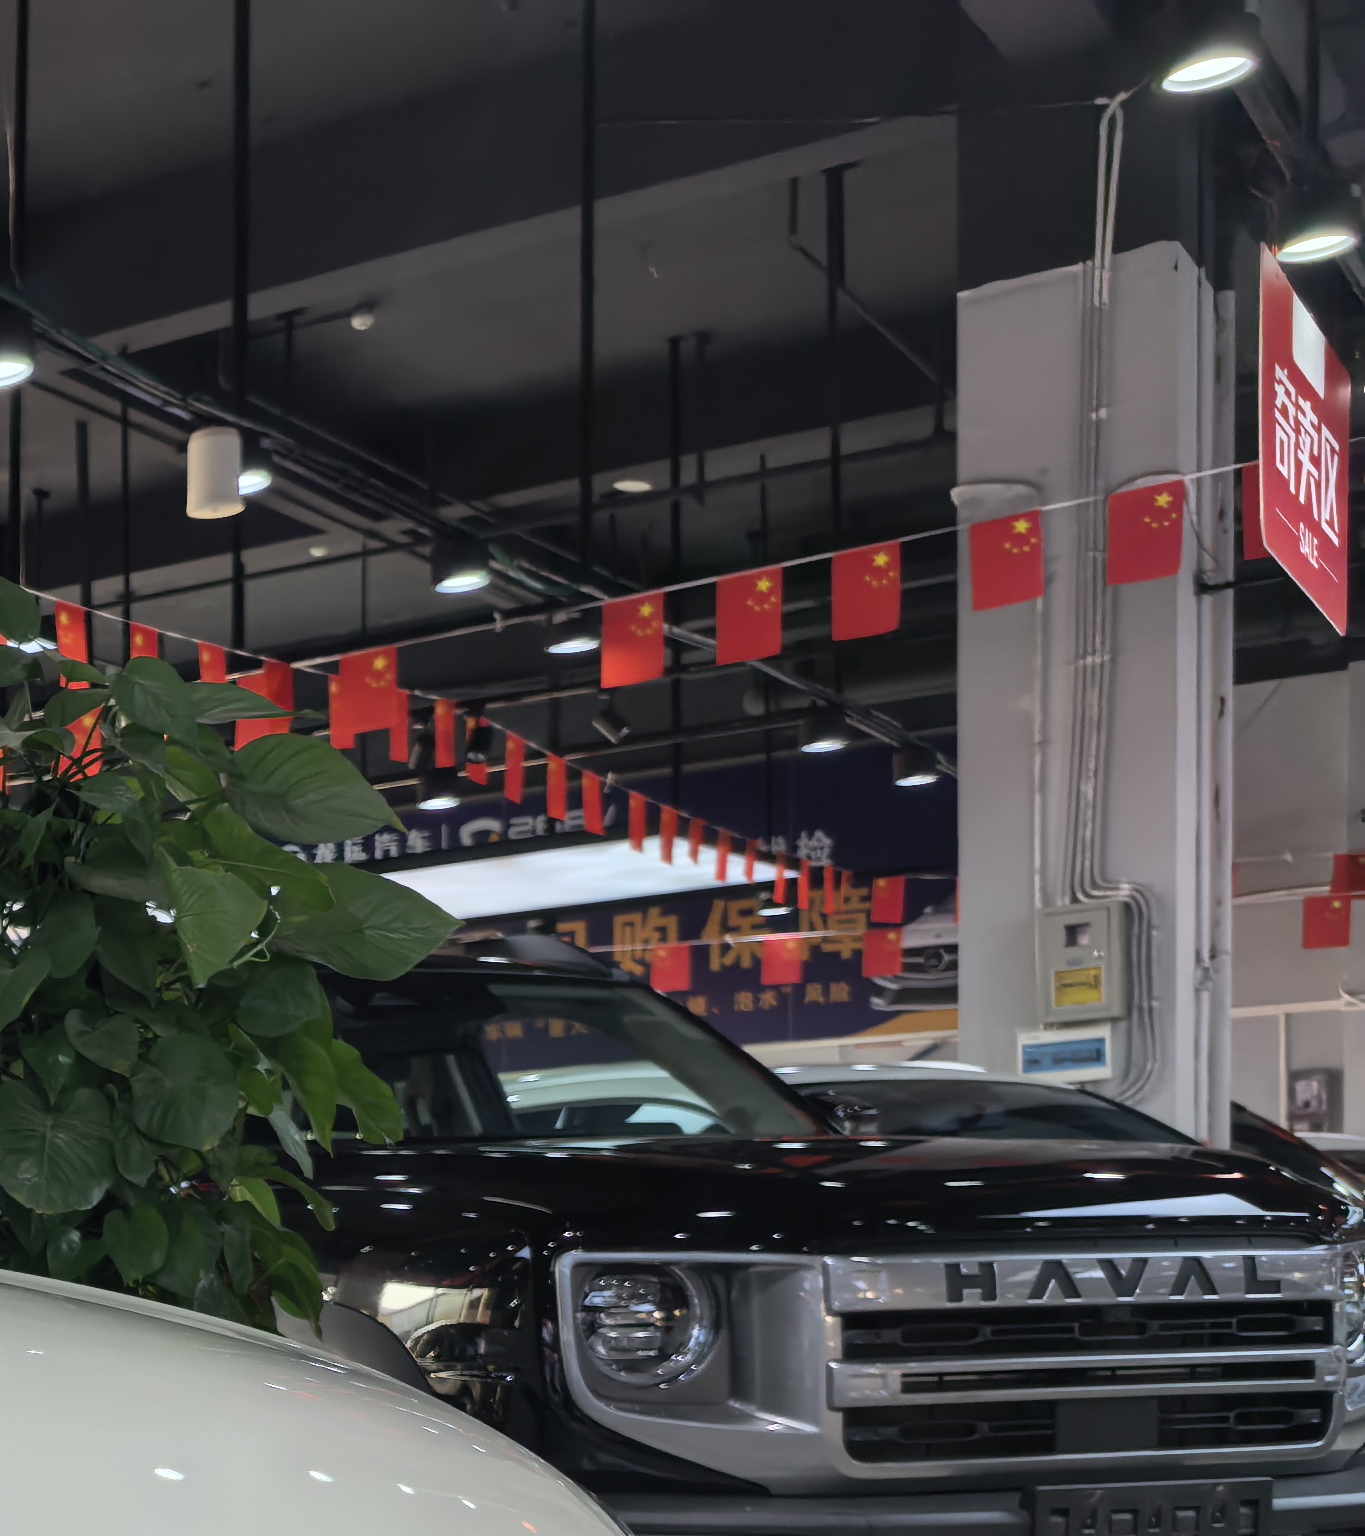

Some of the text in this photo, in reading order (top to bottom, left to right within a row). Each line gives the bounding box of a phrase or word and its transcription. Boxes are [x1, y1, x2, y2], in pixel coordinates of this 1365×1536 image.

[1275, 363, 1339, 547] 寄卖区
[1299, 521, 1319, 569] SALE
[944, 1256, 1283, 1303] HAVAL
